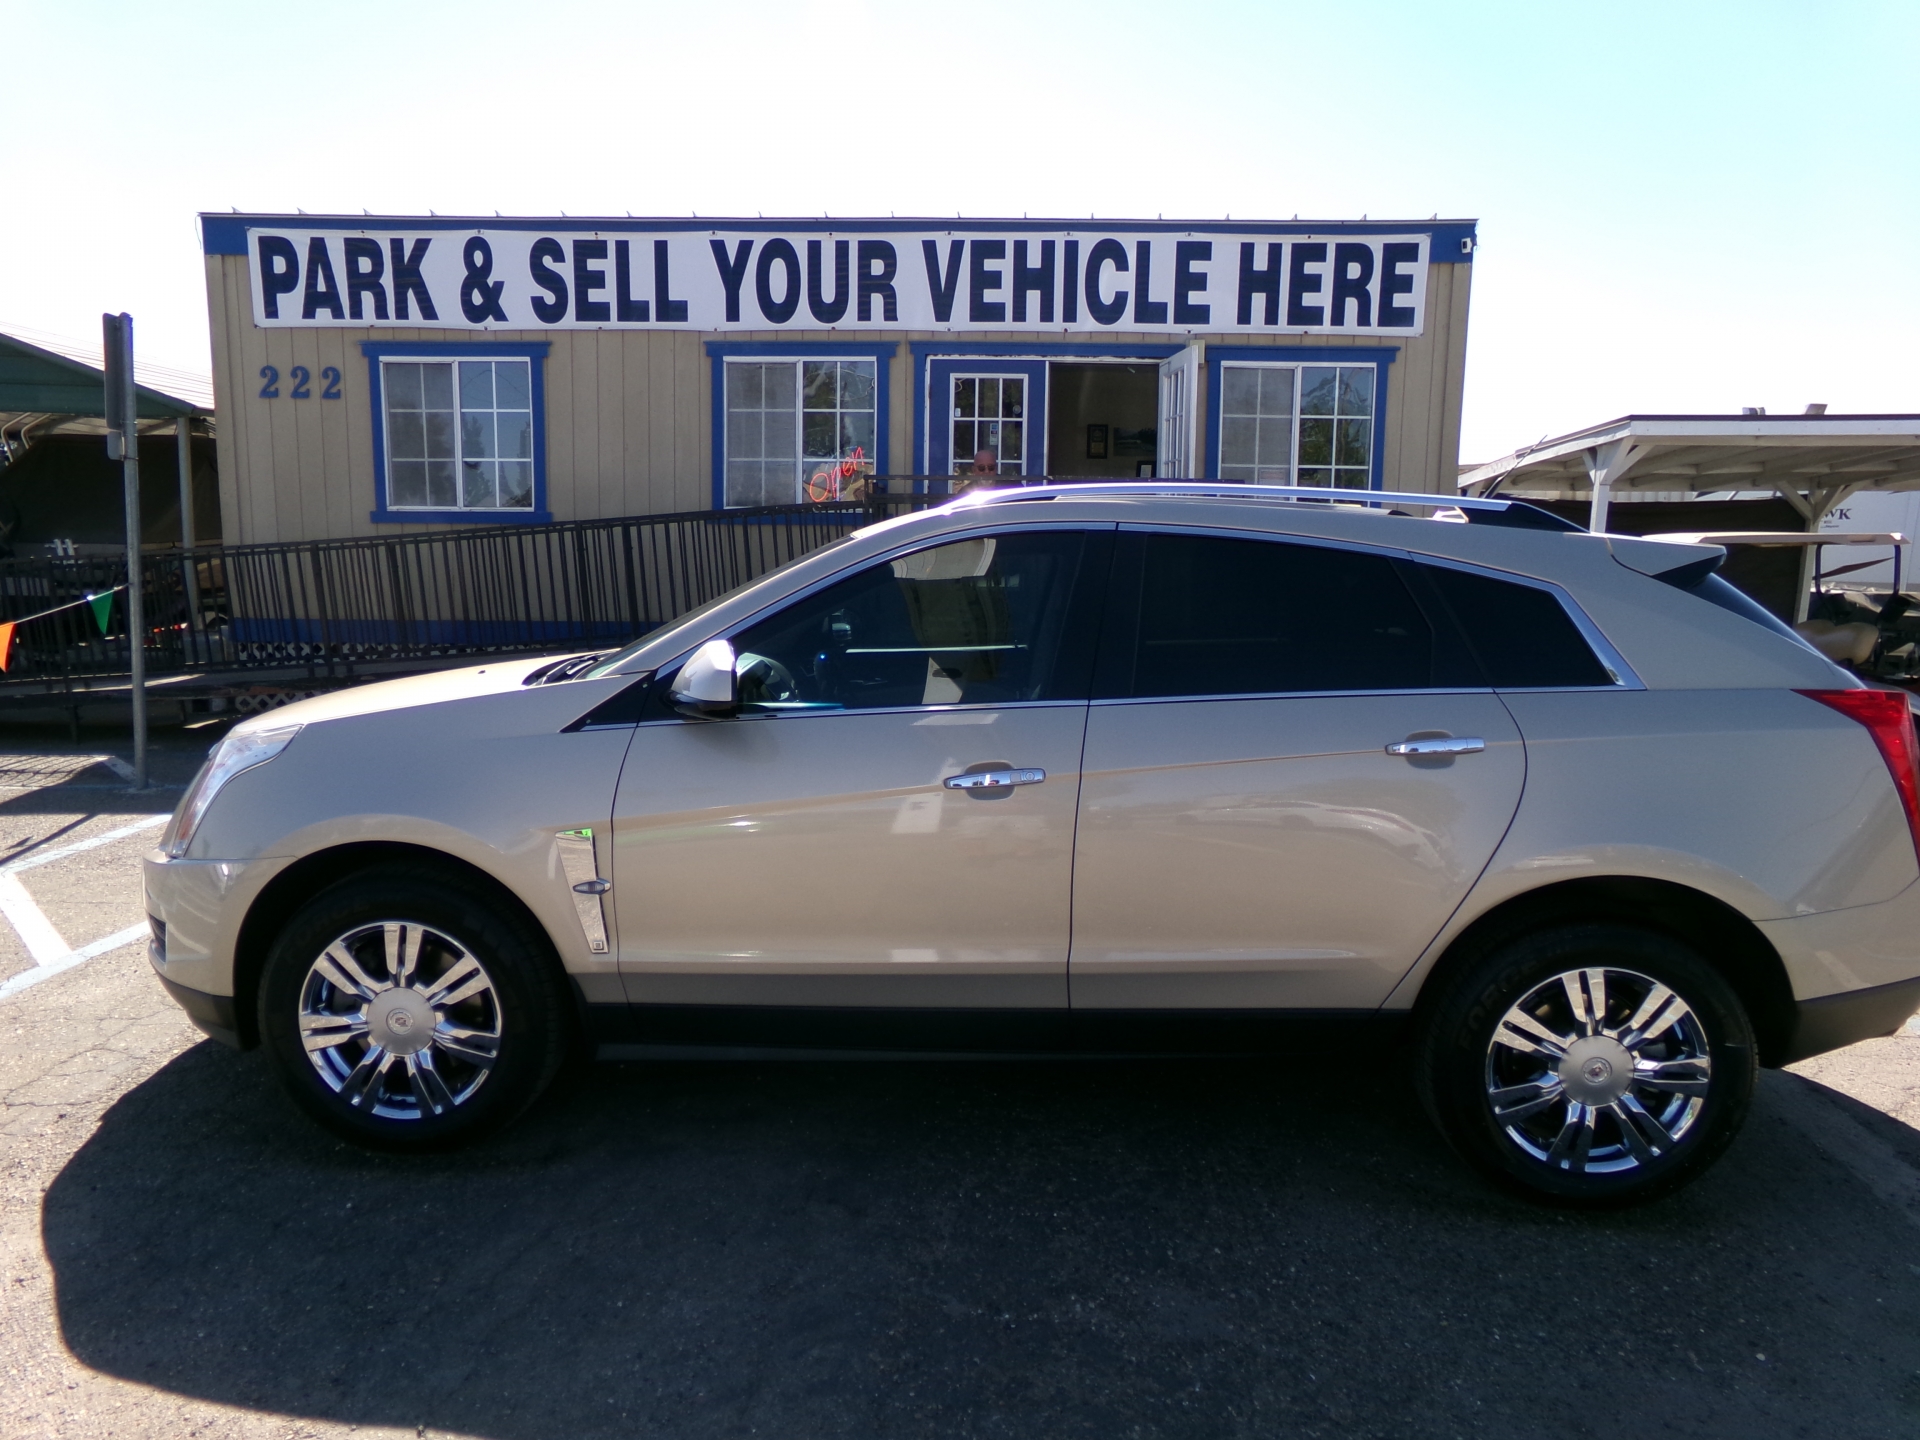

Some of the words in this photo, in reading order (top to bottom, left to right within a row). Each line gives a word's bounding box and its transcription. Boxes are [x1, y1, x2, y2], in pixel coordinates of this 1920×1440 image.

[257, 235, 440, 321] PARK
[460, 235, 509, 324] &
[529, 236, 689, 325] SELL
[708, 237, 899, 325] YOUR
[921, 238, 1213, 326] VEHICLE
[1236, 241, 1420, 328] HERE
[259, 365, 341, 400] 222
[809, 445, 865, 503] Open
